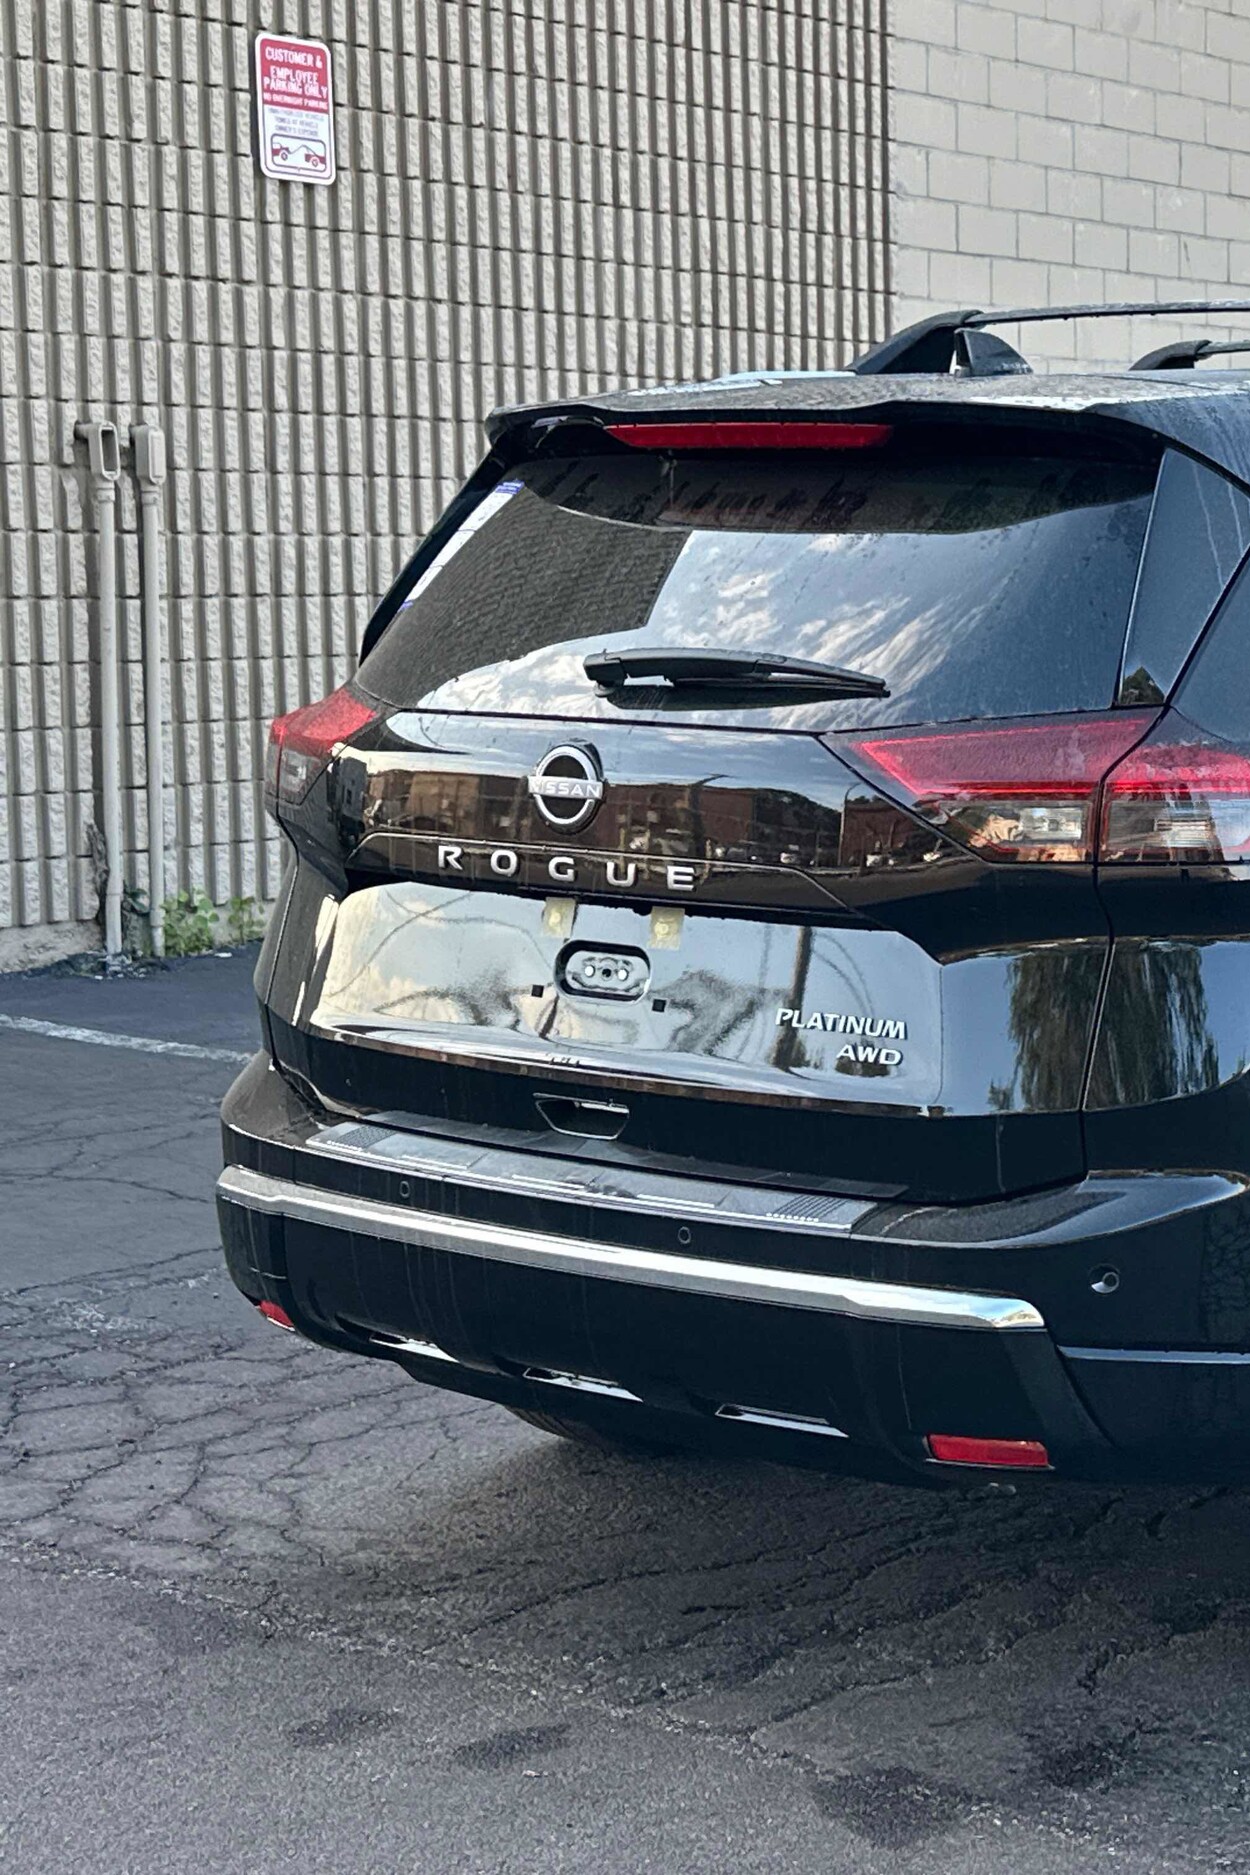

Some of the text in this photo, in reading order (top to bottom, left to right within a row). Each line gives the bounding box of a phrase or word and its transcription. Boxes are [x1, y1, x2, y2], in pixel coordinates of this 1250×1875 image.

[265, 46, 323, 69] CUSTOMER &
[270, 65, 318, 84] EMPLOYEE
[263, 76, 328, 99] PARKING ONLY
[529, 778, 600, 797] NISSAN
[438, 845, 695, 892] ROGUE
[775, 1008, 906, 1039] PLATINUM
[836, 1044, 902, 1066] AWD
